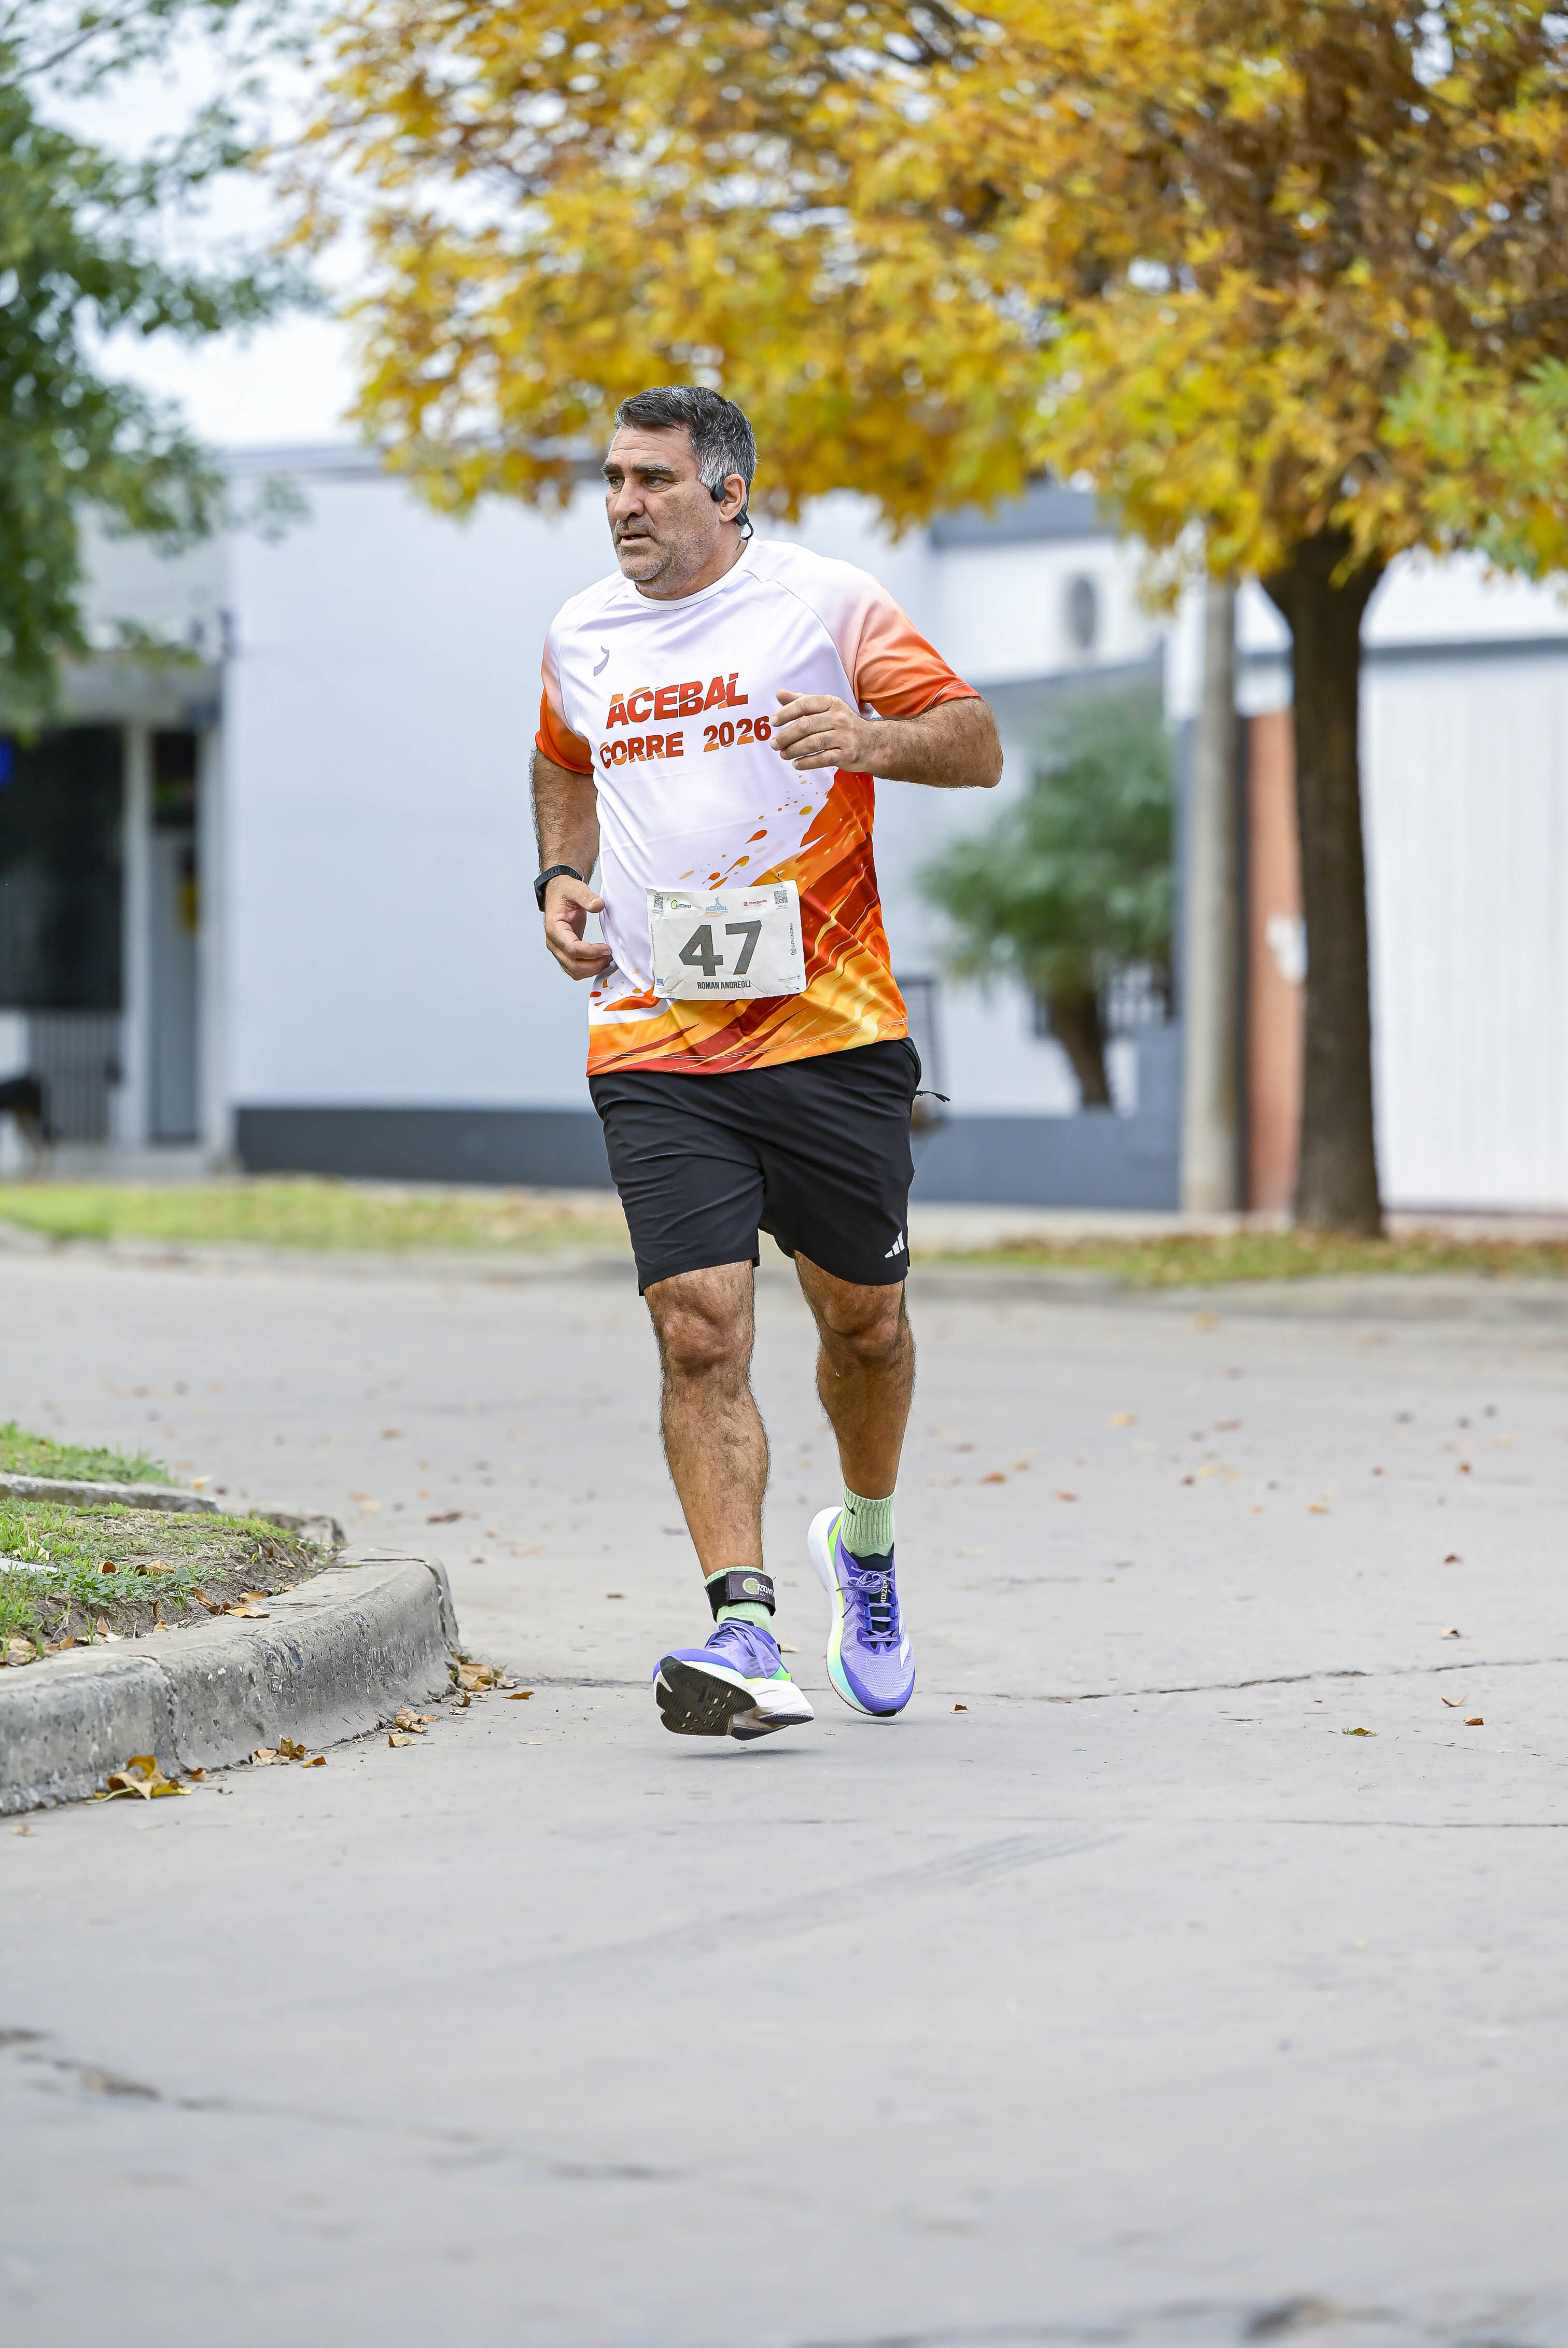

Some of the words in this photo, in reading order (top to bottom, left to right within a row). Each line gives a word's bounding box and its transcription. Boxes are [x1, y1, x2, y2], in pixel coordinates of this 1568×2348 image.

[606, 672, 748, 730] ACEBAL
[599, 731, 684, 769] CORRE
[703, 716, 772, 752] 2026
[678, 920, 762, 976] 47
[721, 980, 751, 989] ANDREOLI
